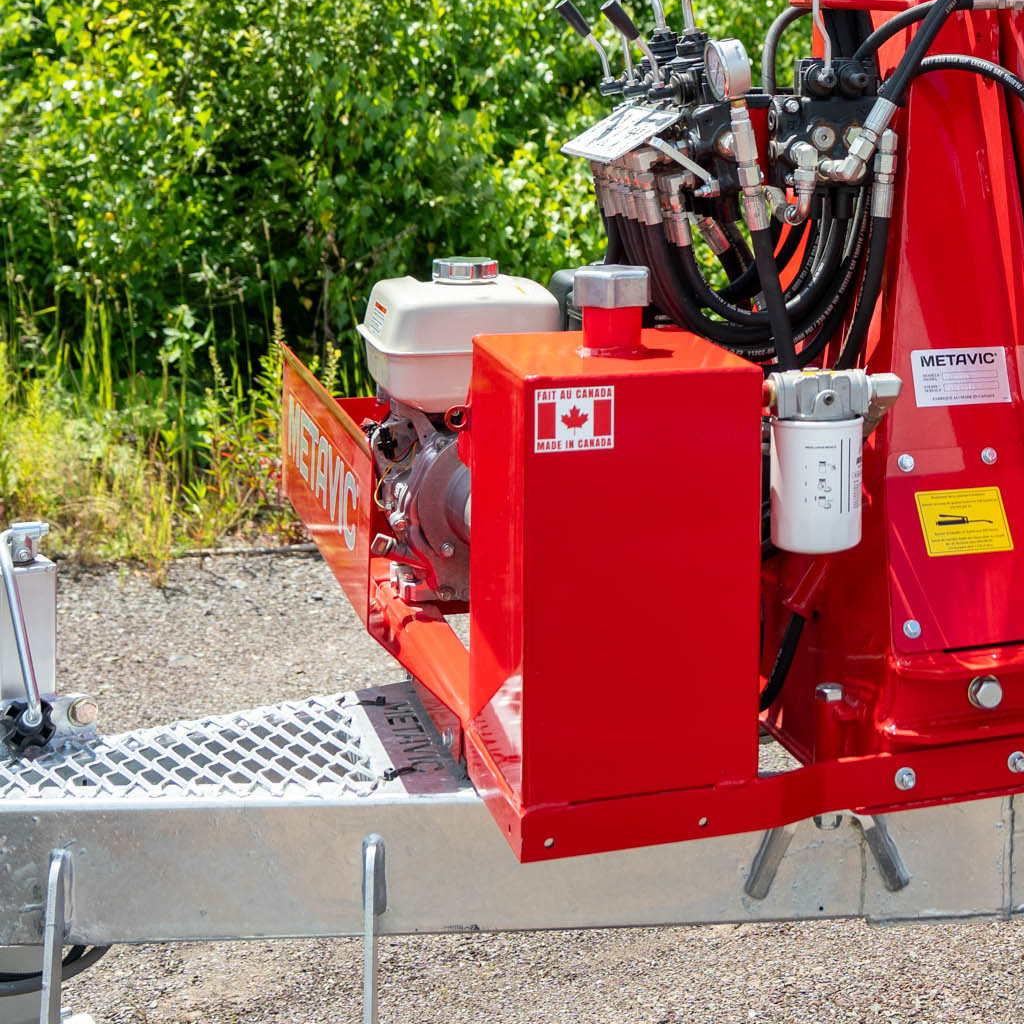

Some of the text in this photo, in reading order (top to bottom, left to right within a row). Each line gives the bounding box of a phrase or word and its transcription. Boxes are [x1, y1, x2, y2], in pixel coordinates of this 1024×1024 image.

[920, 352, 995, 367] METAVIC
[537, 387, 612, 401] FAIT AU CANADA
[537, 437, 612, 451] MADE IN CANADA
[288, 393, 357, 552] METAVIC
